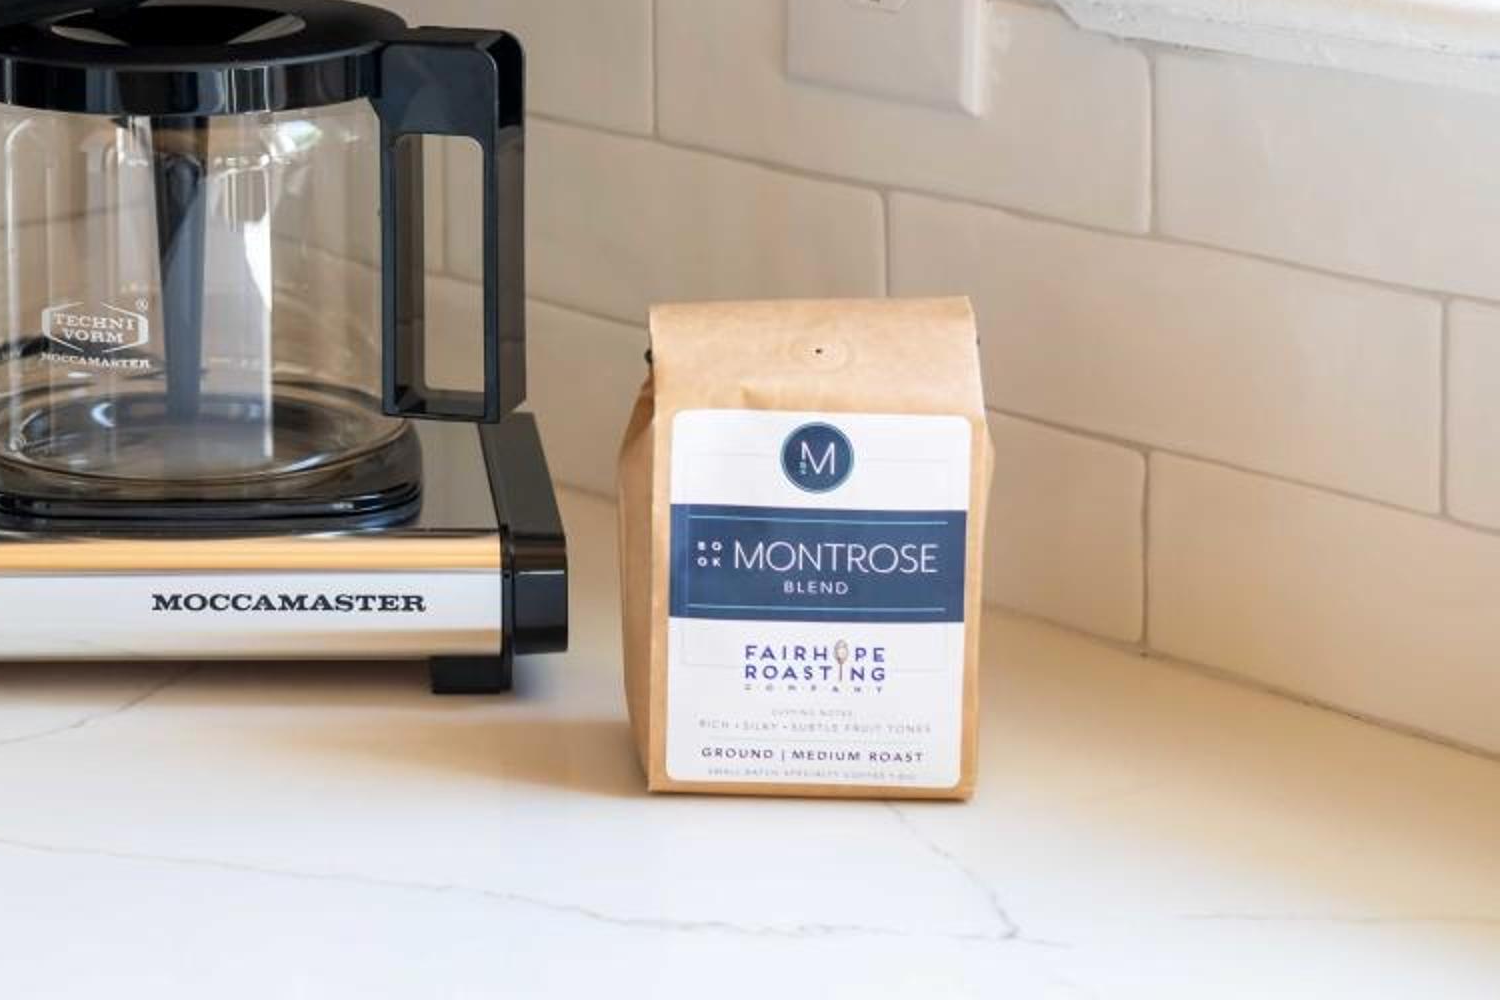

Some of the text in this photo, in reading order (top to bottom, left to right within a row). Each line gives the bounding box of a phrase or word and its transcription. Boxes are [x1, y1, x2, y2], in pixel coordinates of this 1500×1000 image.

[52, 312, 136, 331] TECHNI
[62, 328, 125, 344] VORM
[734, 541, 939, 573] MONTROSE
[783, 580, 849, 595] BLEND
[152, 593, 426, 612] MOCCAMASTER
[701, 748, 923, 763] GROUND MEDIUM ROAST
